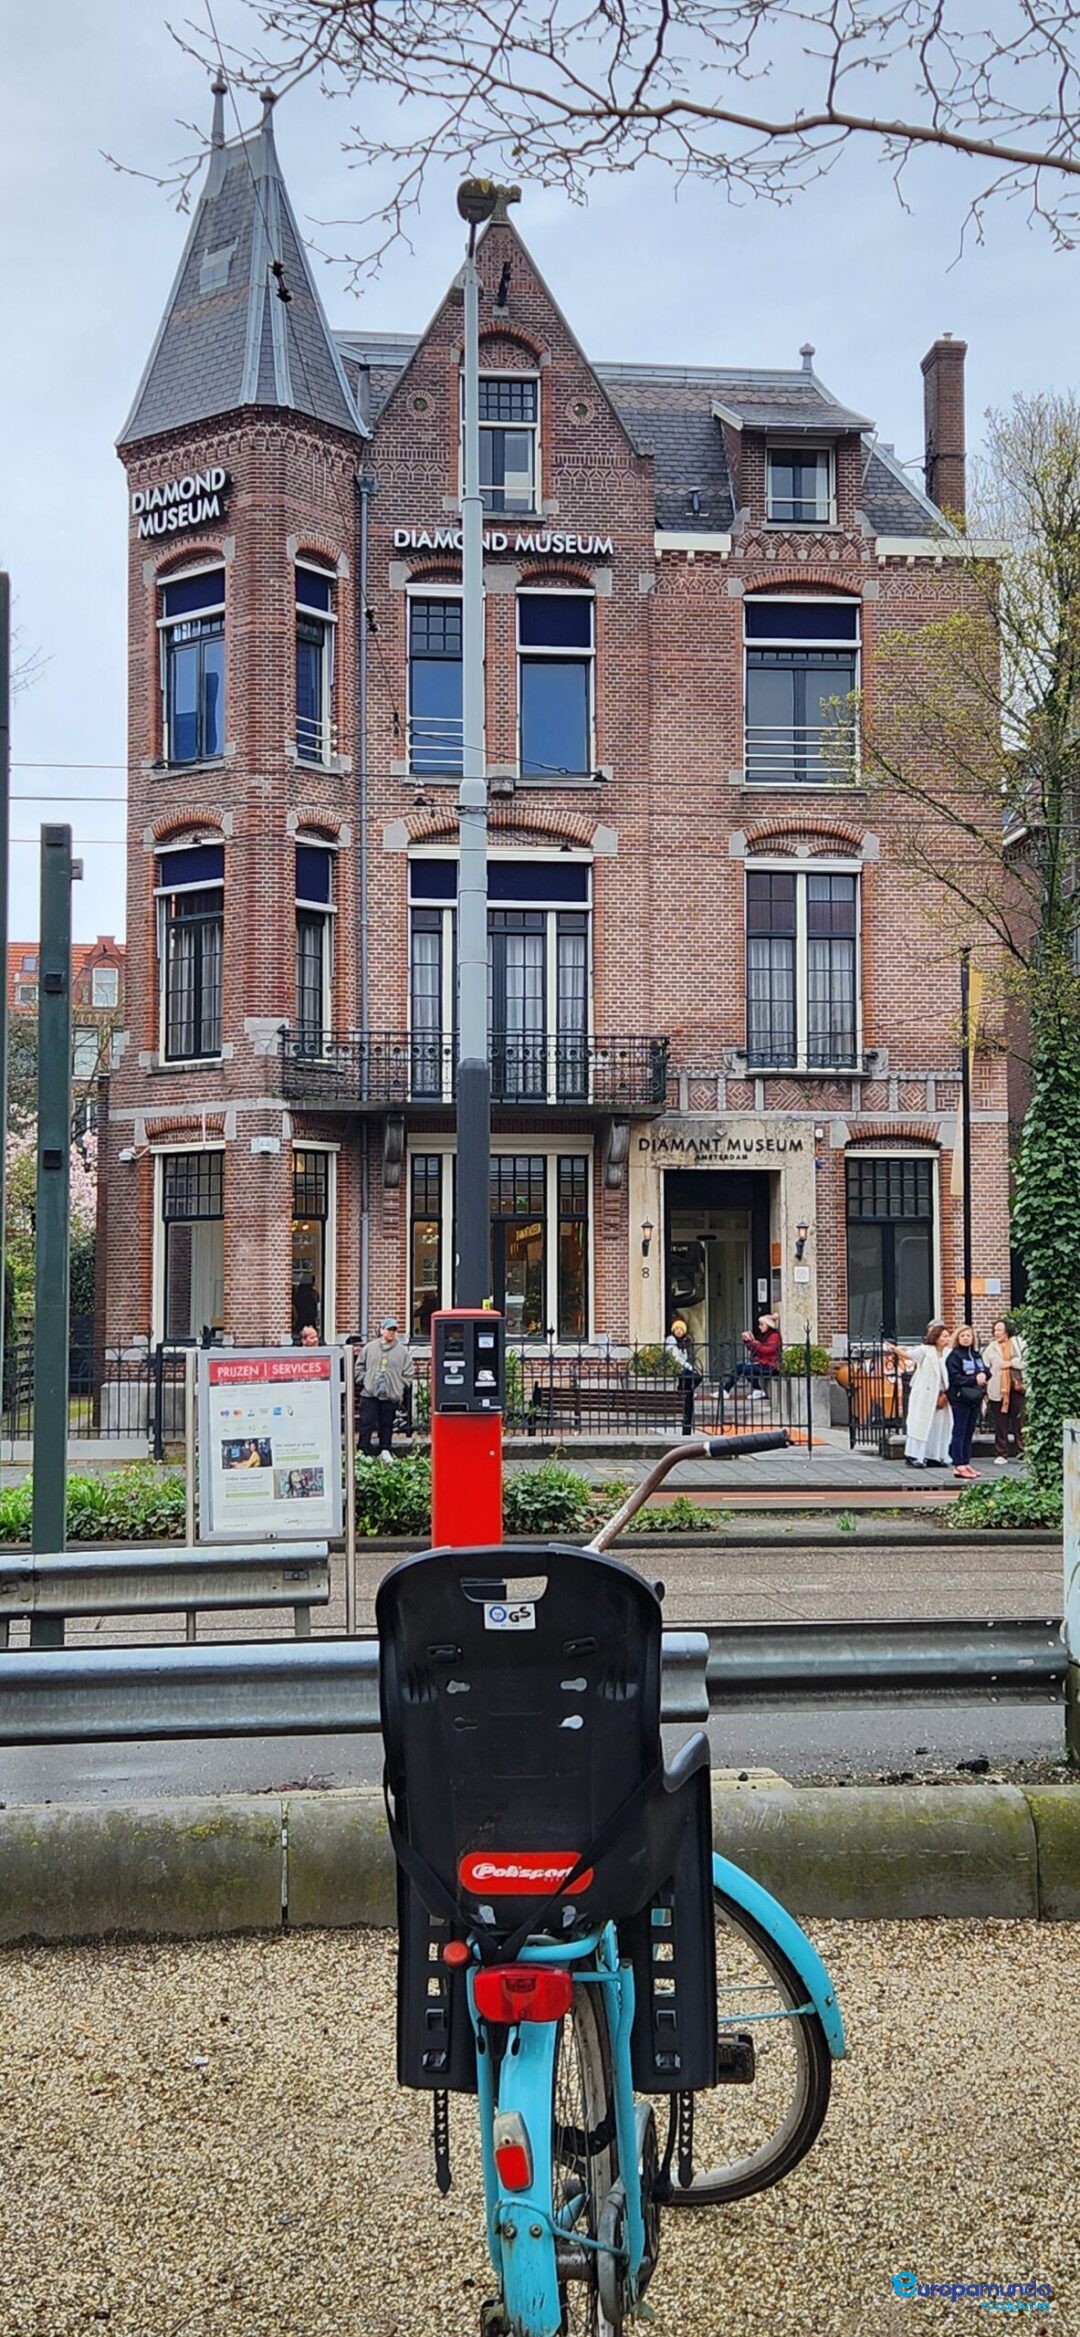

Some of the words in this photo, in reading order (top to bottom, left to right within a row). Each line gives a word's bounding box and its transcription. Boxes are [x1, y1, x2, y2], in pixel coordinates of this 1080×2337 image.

[131, 467, 226, 515] DIAMOND
[137, 494, 220, 539] MUSEUM
[514, 532, 614, 555] MUSEUM
[639, 1138, 721, 1151] DIAMANT
[727, 1138, 803, 1152] MUSEUM
[695, 1153, 748, 1161] AMSTERDAM
[641, 1266, 650, 1279] 8
[217, 1365, 260, 1378] PRIJZEN
[272, 1362, 322, 1375] SERVICES
[509, 1606, 531, 1623] GS
